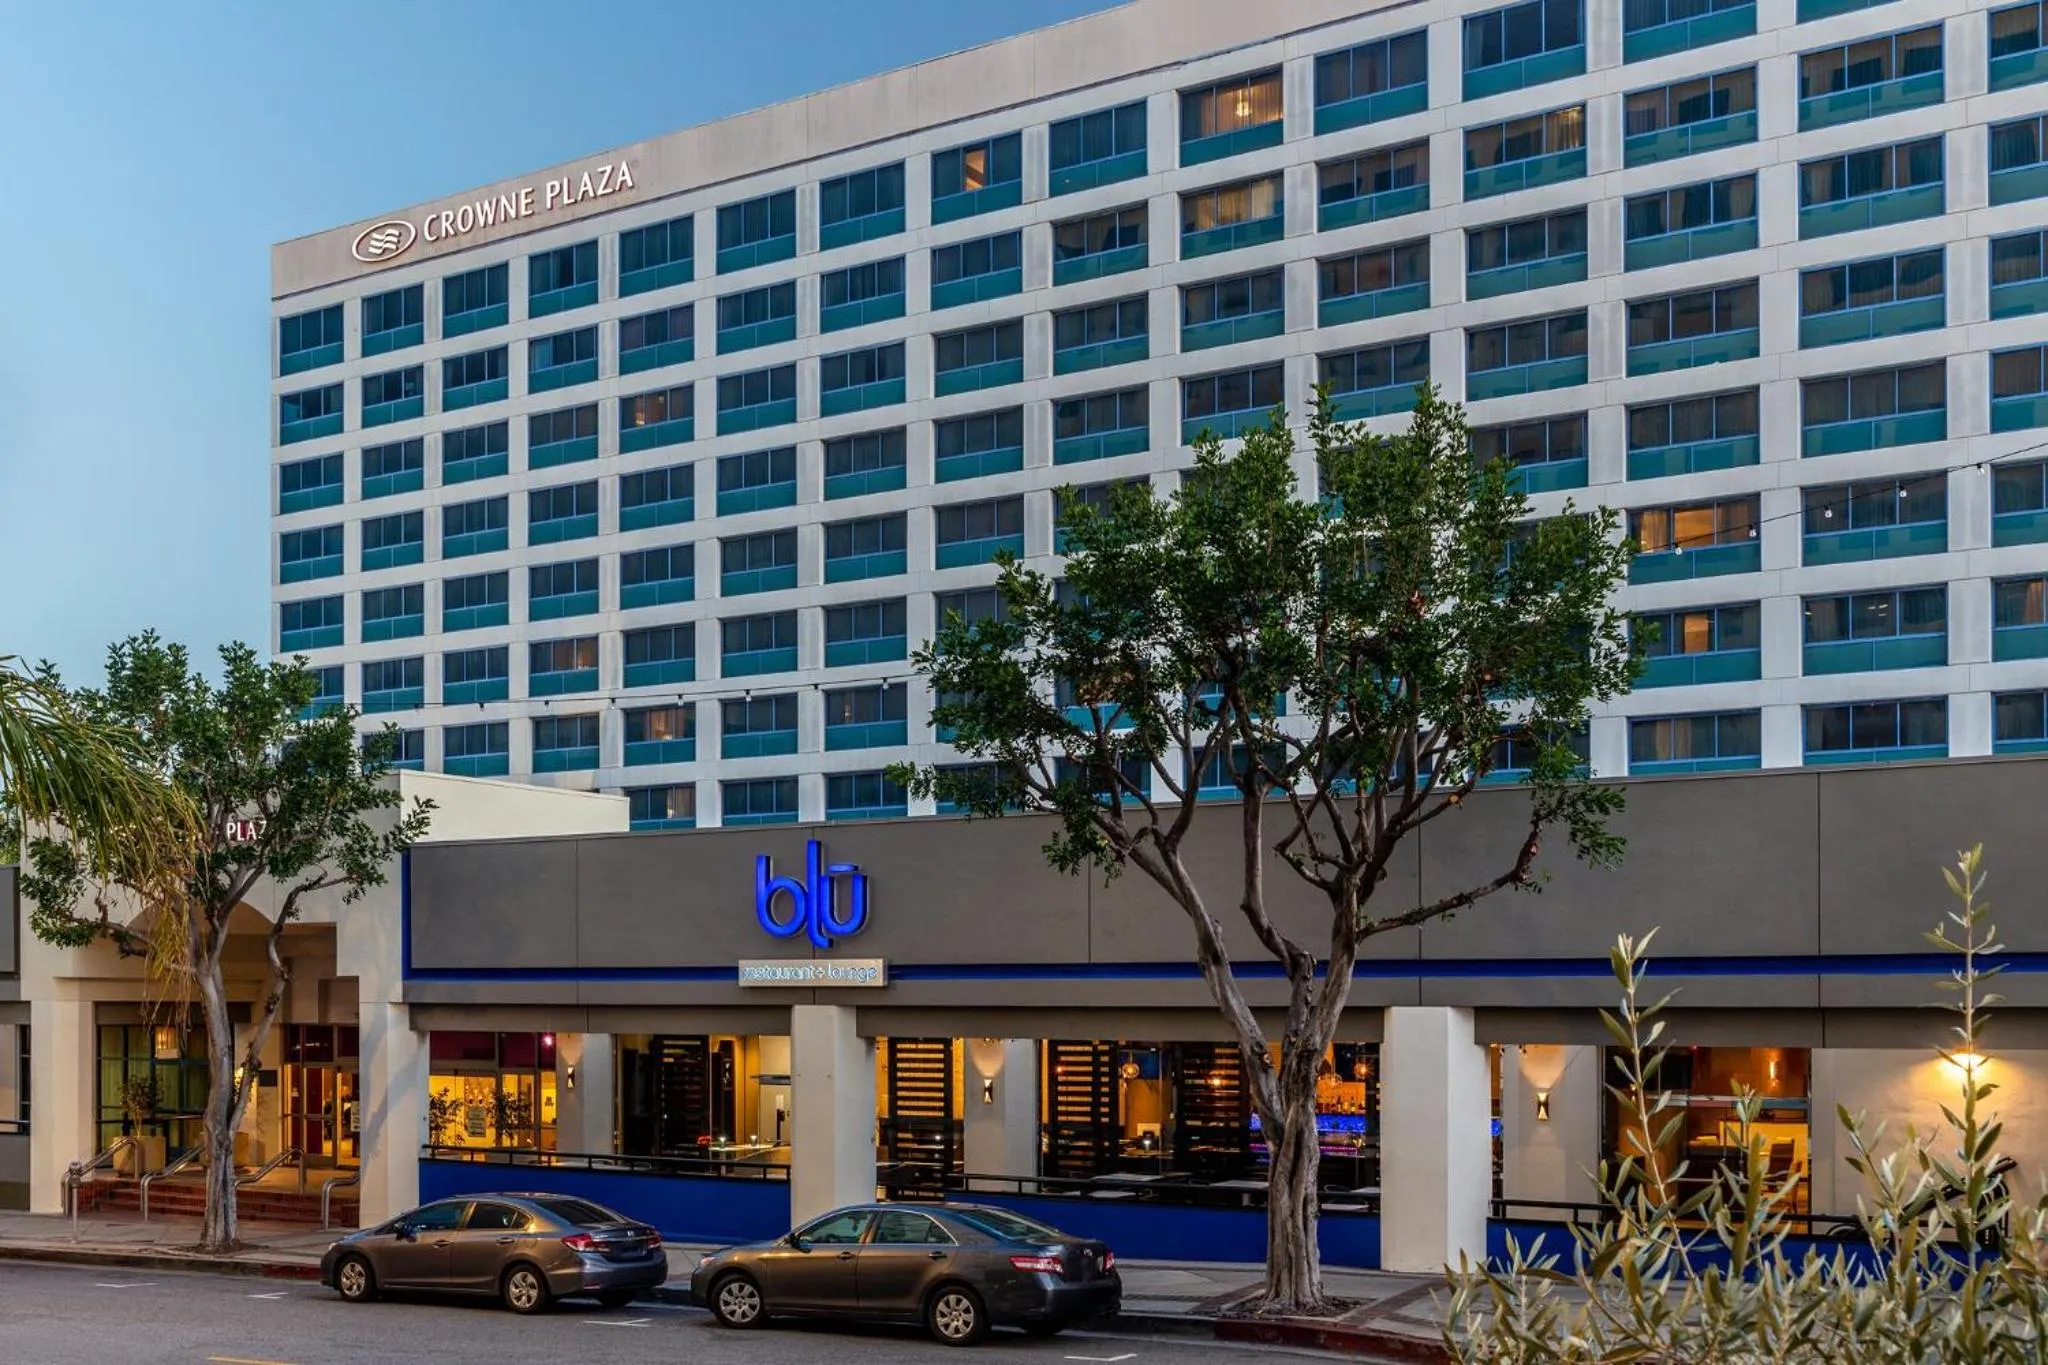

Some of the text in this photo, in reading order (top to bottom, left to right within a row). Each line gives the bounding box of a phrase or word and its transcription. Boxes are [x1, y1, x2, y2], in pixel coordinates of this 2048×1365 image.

[424, 161, 635, 242] CROWNE PLAZA
[226, 820, 267, 841] PLAZ
